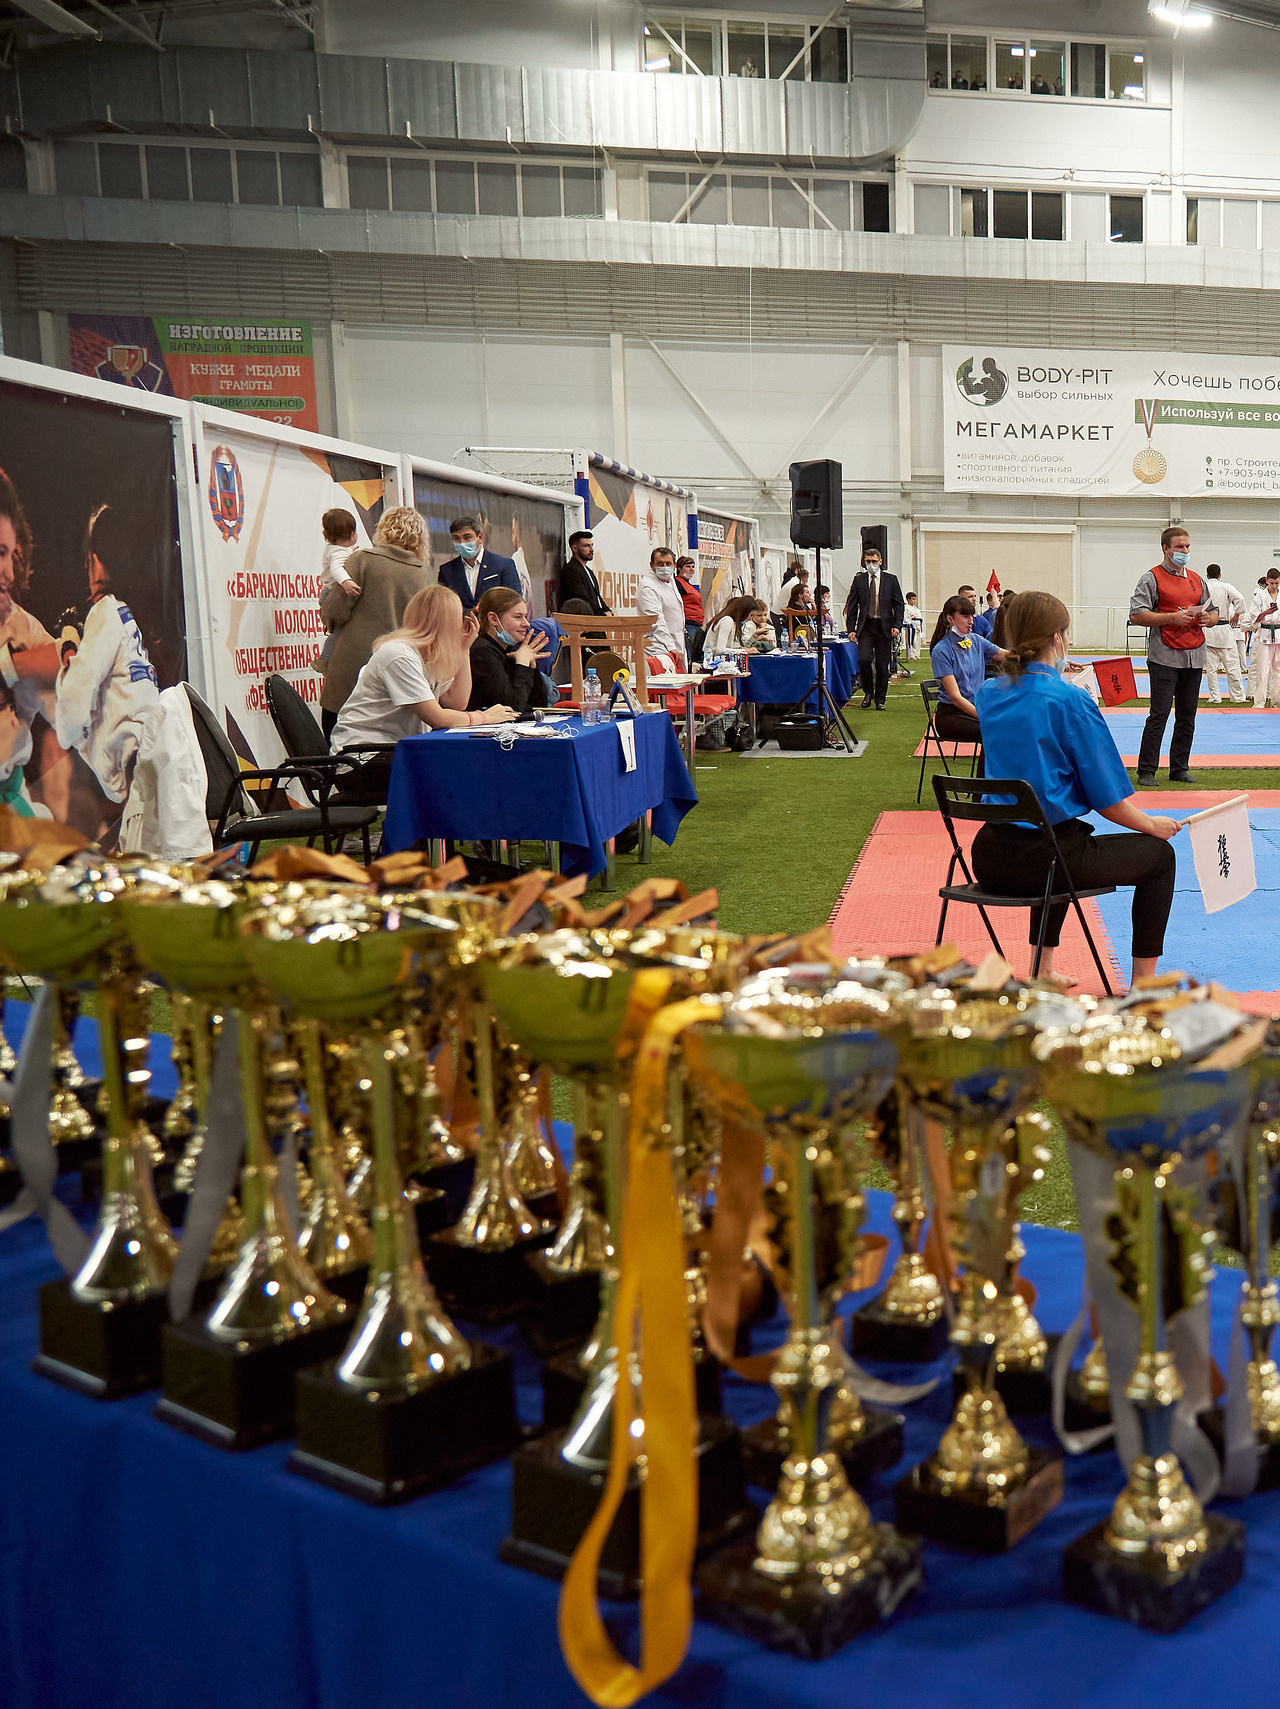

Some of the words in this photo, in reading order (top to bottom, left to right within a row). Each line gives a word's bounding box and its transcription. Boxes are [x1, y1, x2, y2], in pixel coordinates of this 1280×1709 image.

[168, 323, 303, 342] ИЗГОТОВЛЕНИЕ
[170, 341, 232, 354] НАГРАДНОЙ
[240, 343, 304, 354] ПРОДУКЦИИ
[190, 363, 235, 376] КУБКИ
[245, 364, 301, 377] МЕДАЛИ
[1017, 367, 1113, 384] BODY-PIT
[219, 380, 273, 391] ГРАМОТЫ
[1153, 370, 1232, 389] Хочешь
[1017, 387, 1058, 400] выбор
[1061, 392, 1113, 401] сильных
[1161, 405, 1234, 421] Используй
[1238, 411, 1261, 421] все
[956, 420, 1114, 441] МЕГАМАРКЕТ
[961, 452, 1019, 463] витаминов,
[1021, 454, 1064, 464] добавок
[1217, 458, 1232, 467] пр.
[961, 464, 1028, 474] спортивного
[1030, 465, 1072, 474] питания
[961, 475, 1054, 485] низкокалорийных
[1057, 476, 1110, 486] сладостей
[227, 573, 322, 599] «БАРНАУЛЬСКАЯ
[274, 609, 326, 638] МОЛОДЕ
[235, 643, 320, 678] ОБЩЕСТВЕННАЯ
